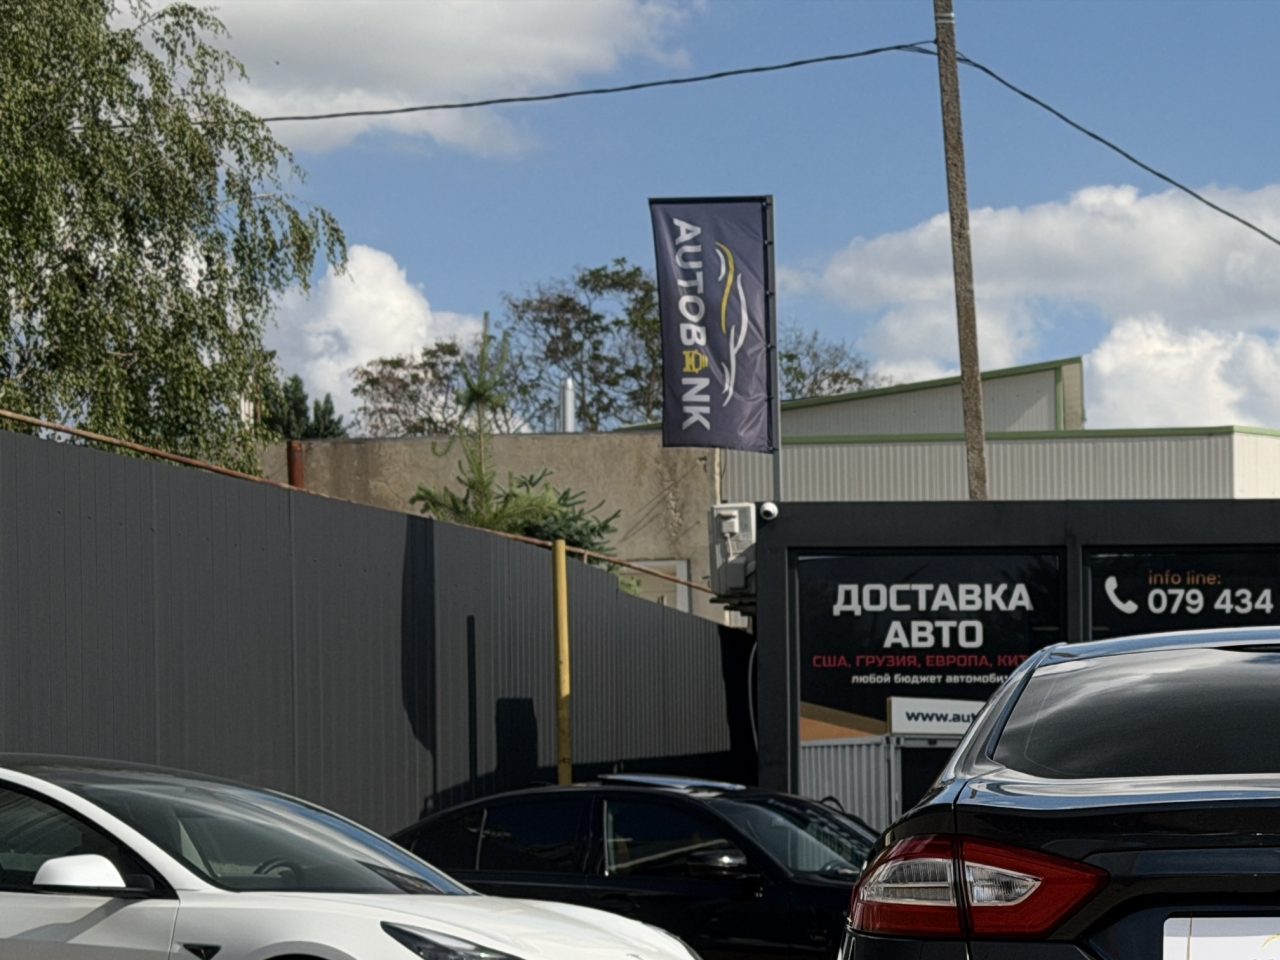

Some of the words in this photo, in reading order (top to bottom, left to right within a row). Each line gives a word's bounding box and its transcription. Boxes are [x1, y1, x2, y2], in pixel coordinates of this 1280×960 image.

[1148, 570, 1181, 585] info
[1187, 570, 1222, 585] line:
[833, 583, 1034, 616] ДОСТАВКА
[1147, 588, 1204, 614] 079
[1213, 588, 1274, 614] 434
[883, 620, 984, 648] АВТО
[812, 655, 851, 669] США,
[856, 655, 921, 669] ГРУЗИЯ,
[926, 655, 993, 669] ЕВРОПА,
[851, 673, 891, 684] любой
[894, 673, 943, 685] бюджет
